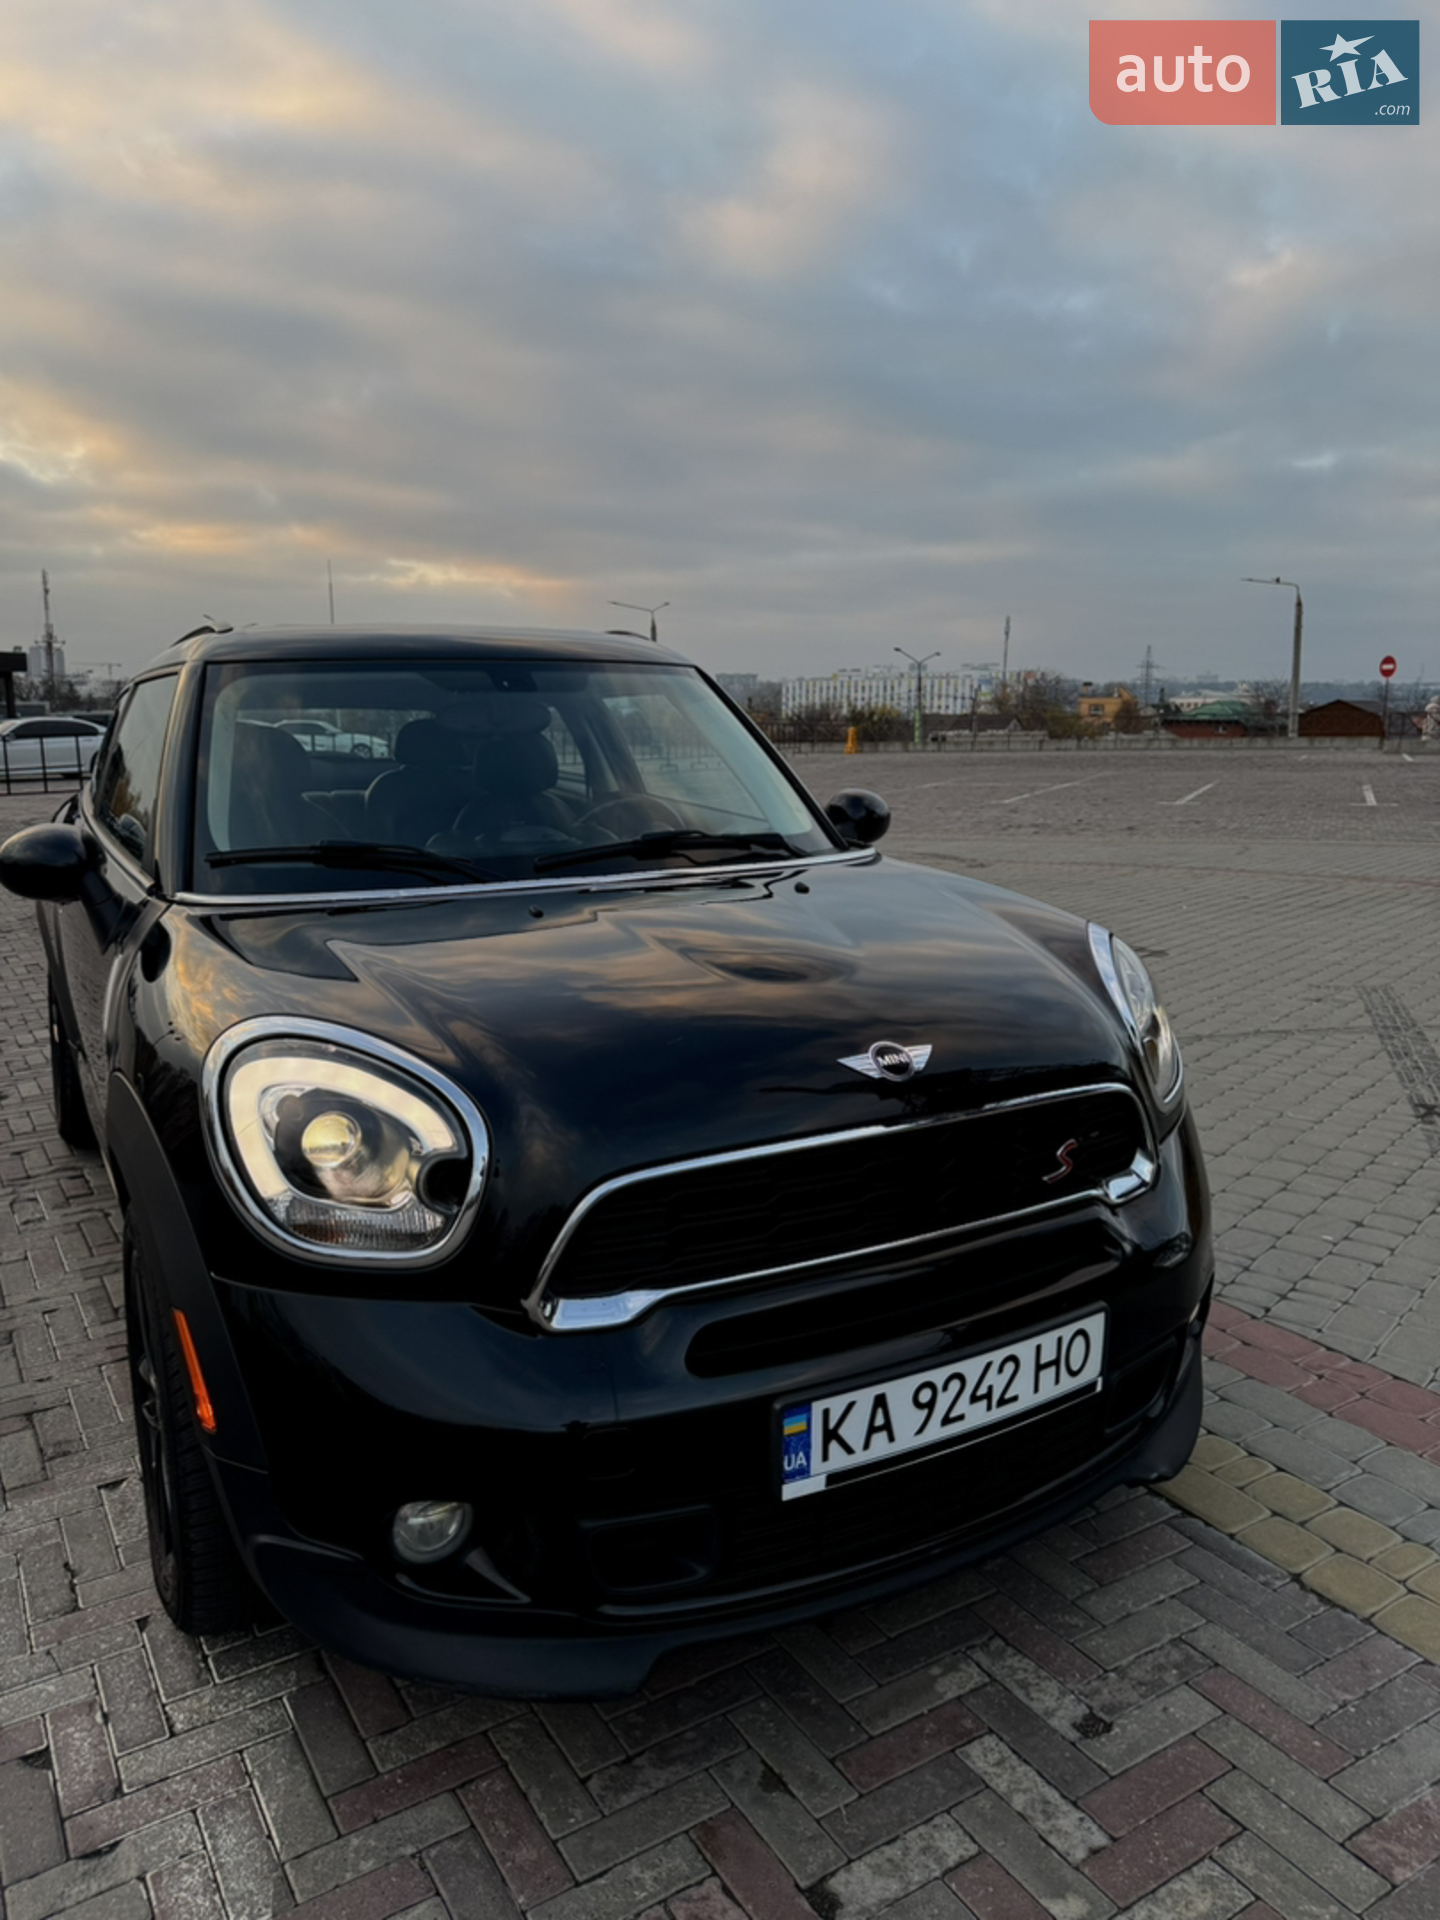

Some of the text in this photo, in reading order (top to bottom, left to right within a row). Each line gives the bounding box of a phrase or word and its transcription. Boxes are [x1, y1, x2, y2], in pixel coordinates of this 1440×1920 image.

[1042, 1138, 1078, 1184] S
[821, 1327, 1091, 1463] KA 9242 HO
[783, 1451, 808, 1471] UA
